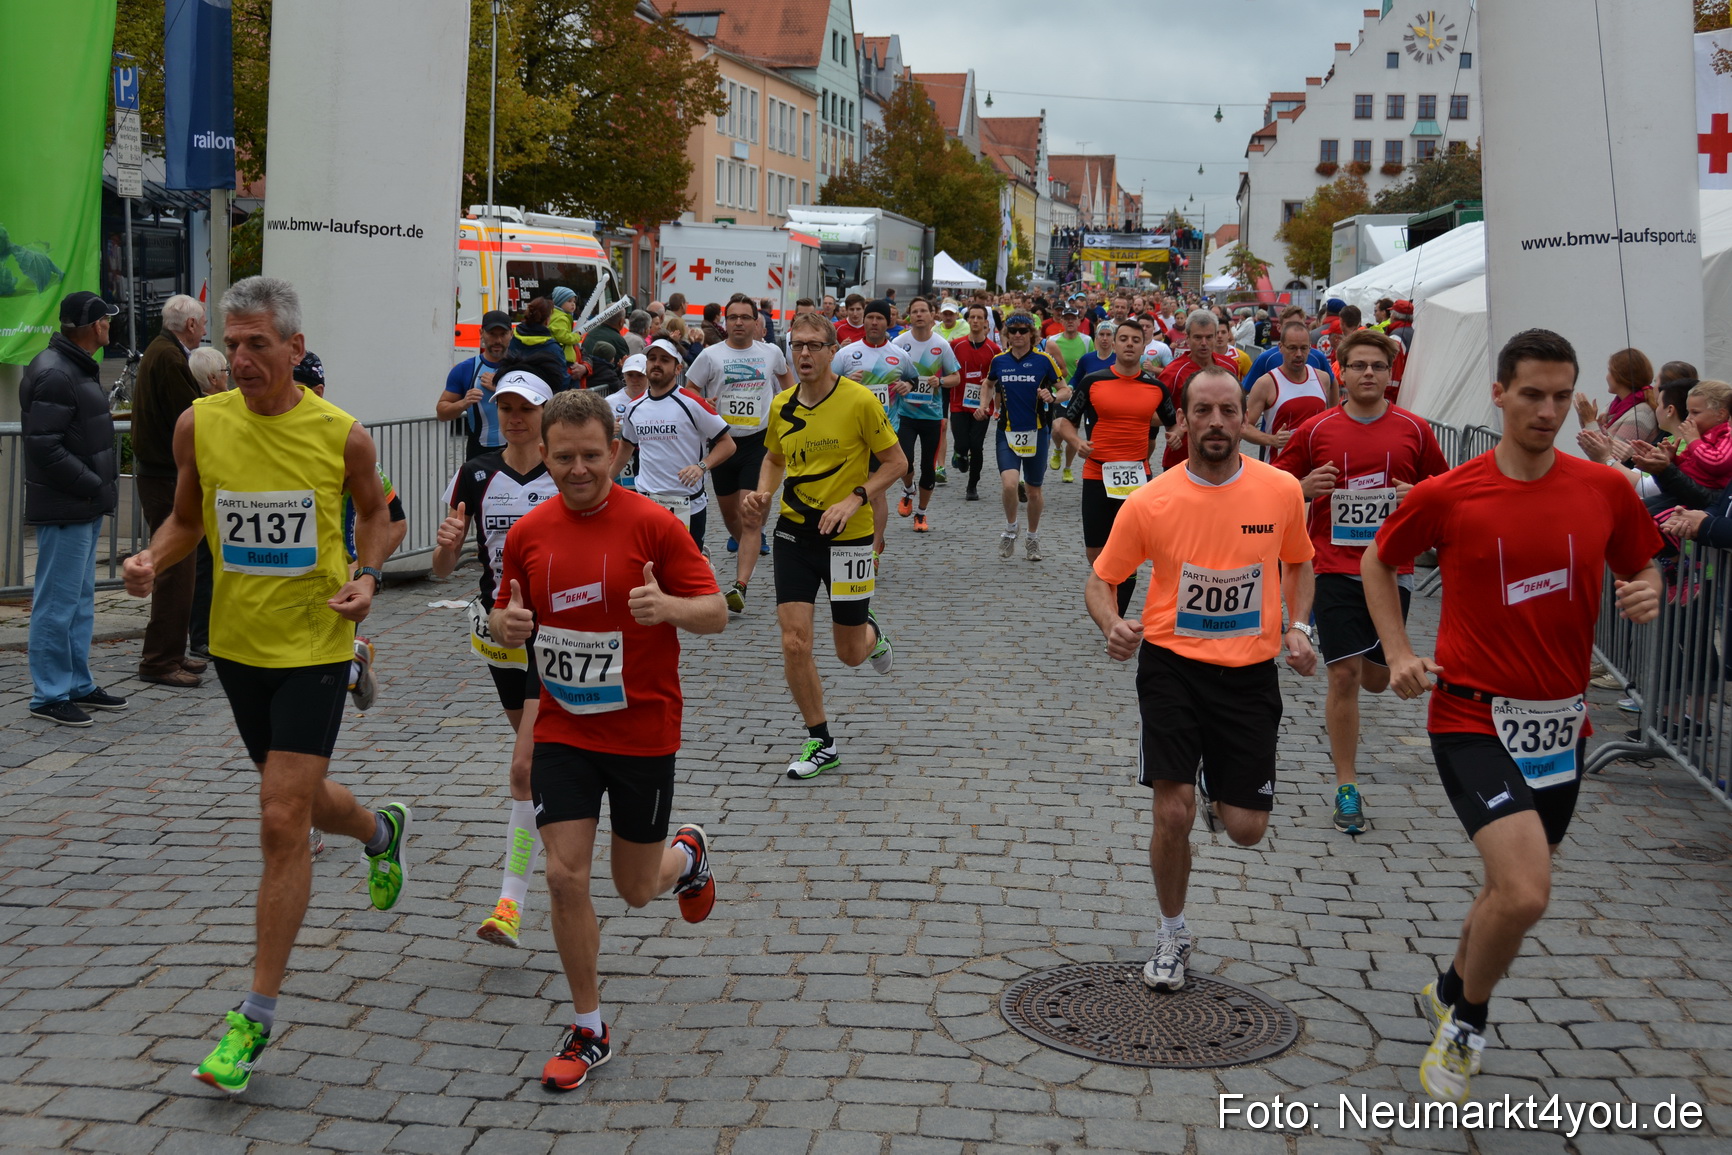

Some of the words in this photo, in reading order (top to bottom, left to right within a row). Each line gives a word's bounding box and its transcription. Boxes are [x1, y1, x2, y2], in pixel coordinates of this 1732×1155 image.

[120, 66, 132, 102] P
[267, 217, 424, 239] www.bmw-laufsport.de
[1521, 228, 1697, 250] www.bmw-laufsport.de
[1109, 251, 1140, 259] START
[715, 258, 757, 268] Bayerisches
[714, 267, 735, 275] Rotes
[714, 275, 734, 284] Kreuz
[935, 279, 963, 288] Laufsport
[583, 299, 629, 333] bmw-laufsport.de
[1001, 374, 1036, 383] BOCK
[729, 401, 754, 415] 526
[636, 424, 678, 436] ERDINGER
[806, 438, 839, 448] Triathlon
[1014, 434, 1028, 446] 23
[1112, 471, 1139, 485] 535
[1357, 478, 1375, 486] DEHN
[217, 498, 248, 508] PARTL
[250, 500, 298, 508] Neumarkt
[1337, 502, 1390, 524] 2524
[226, 512, 307, 544] 2137
[1241, 524, 1274, 534] THULE
[247, 551, 289, 564] Rudolf
[844, 558, 872, 580] 107
[1182, 570, 1210, 583] PARTL
[1212, 573, 1250, 584] Neumarkt
[850, 584, 867, 593] Klaus
[1523, 578, 1550, 594] DEHN
[565, 590, 588, 603] DEHN
[1186, 581, 1255, 613] 2087
[1202, 618, 1236, 629] Marco
[537, 633, 560, 645] PARTL
[561, 638, 605, 649] Neumarkt
[543, 648, 613, 683] 2677
[558, 687, 600, 701] Thomas
[1494, 705, 1527, 715] PARTL
[1502, 716, 1577, 753] 2335
